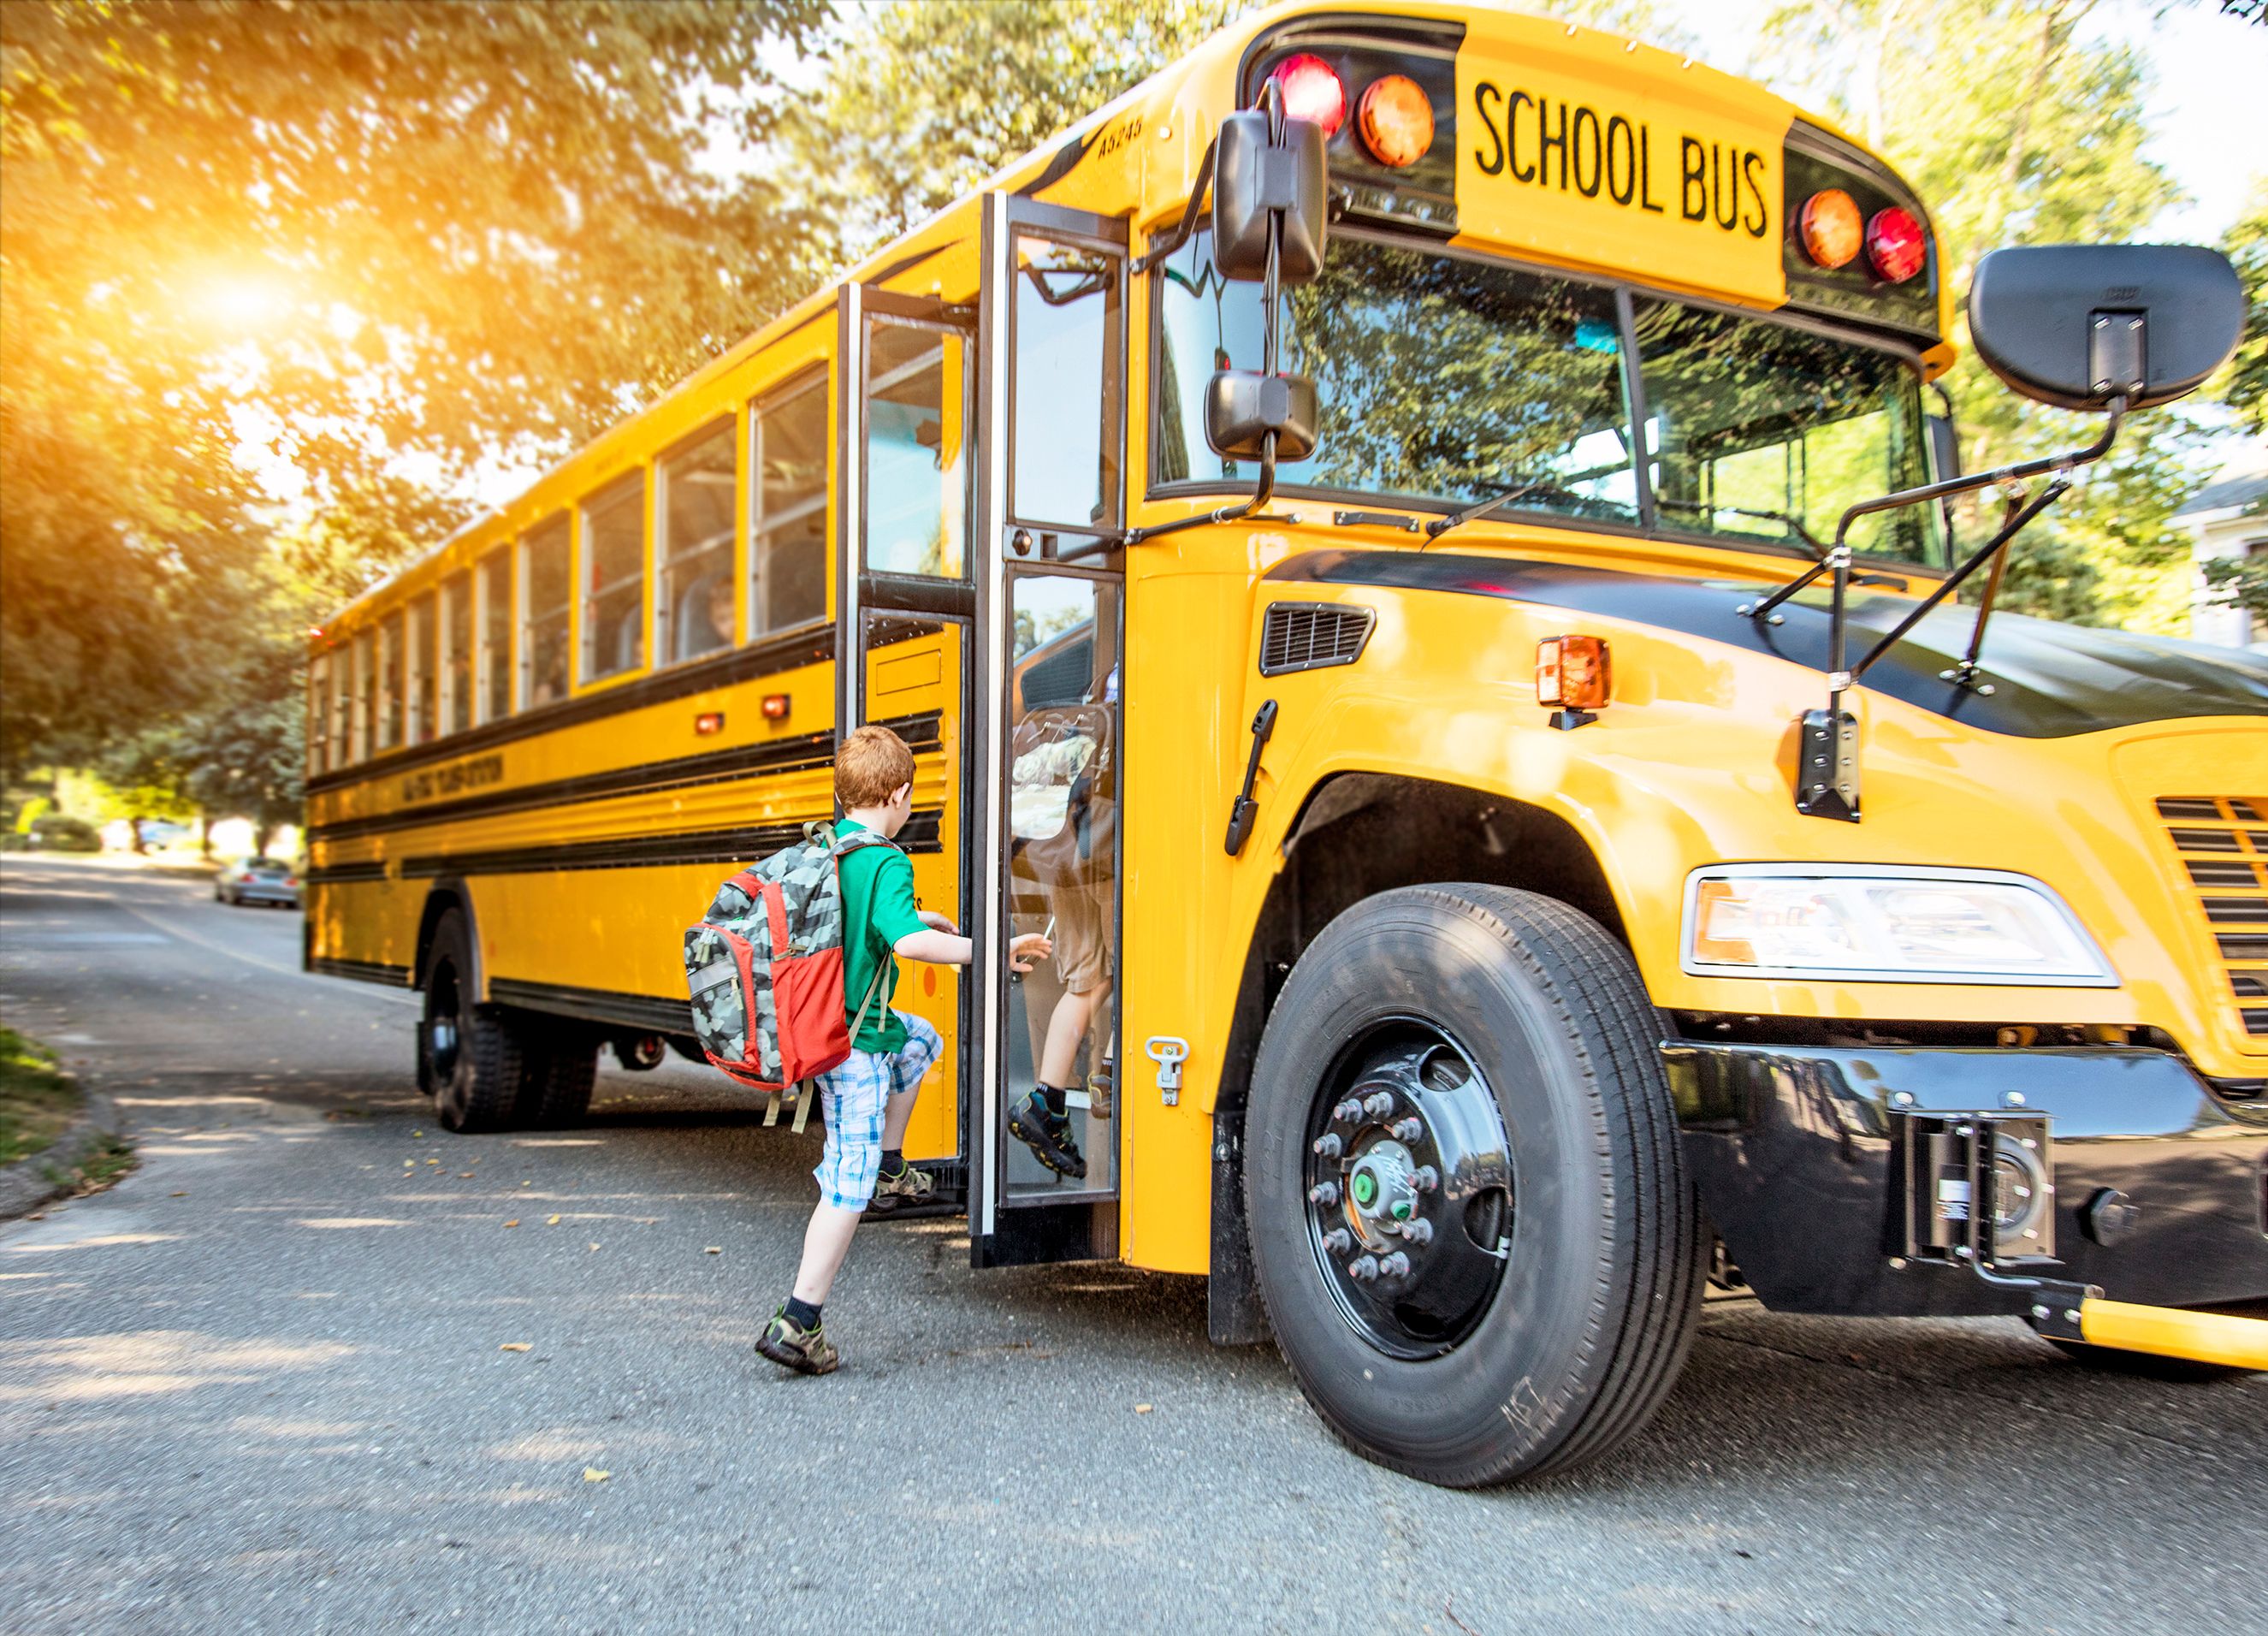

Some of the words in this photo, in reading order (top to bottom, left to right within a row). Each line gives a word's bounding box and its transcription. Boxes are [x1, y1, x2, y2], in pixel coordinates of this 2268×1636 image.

[1098, 117, 1143, 160] A5245
[1475, 81, 1665, 213] SCHOOL
[1681, 135, 1768, 239] BUS
